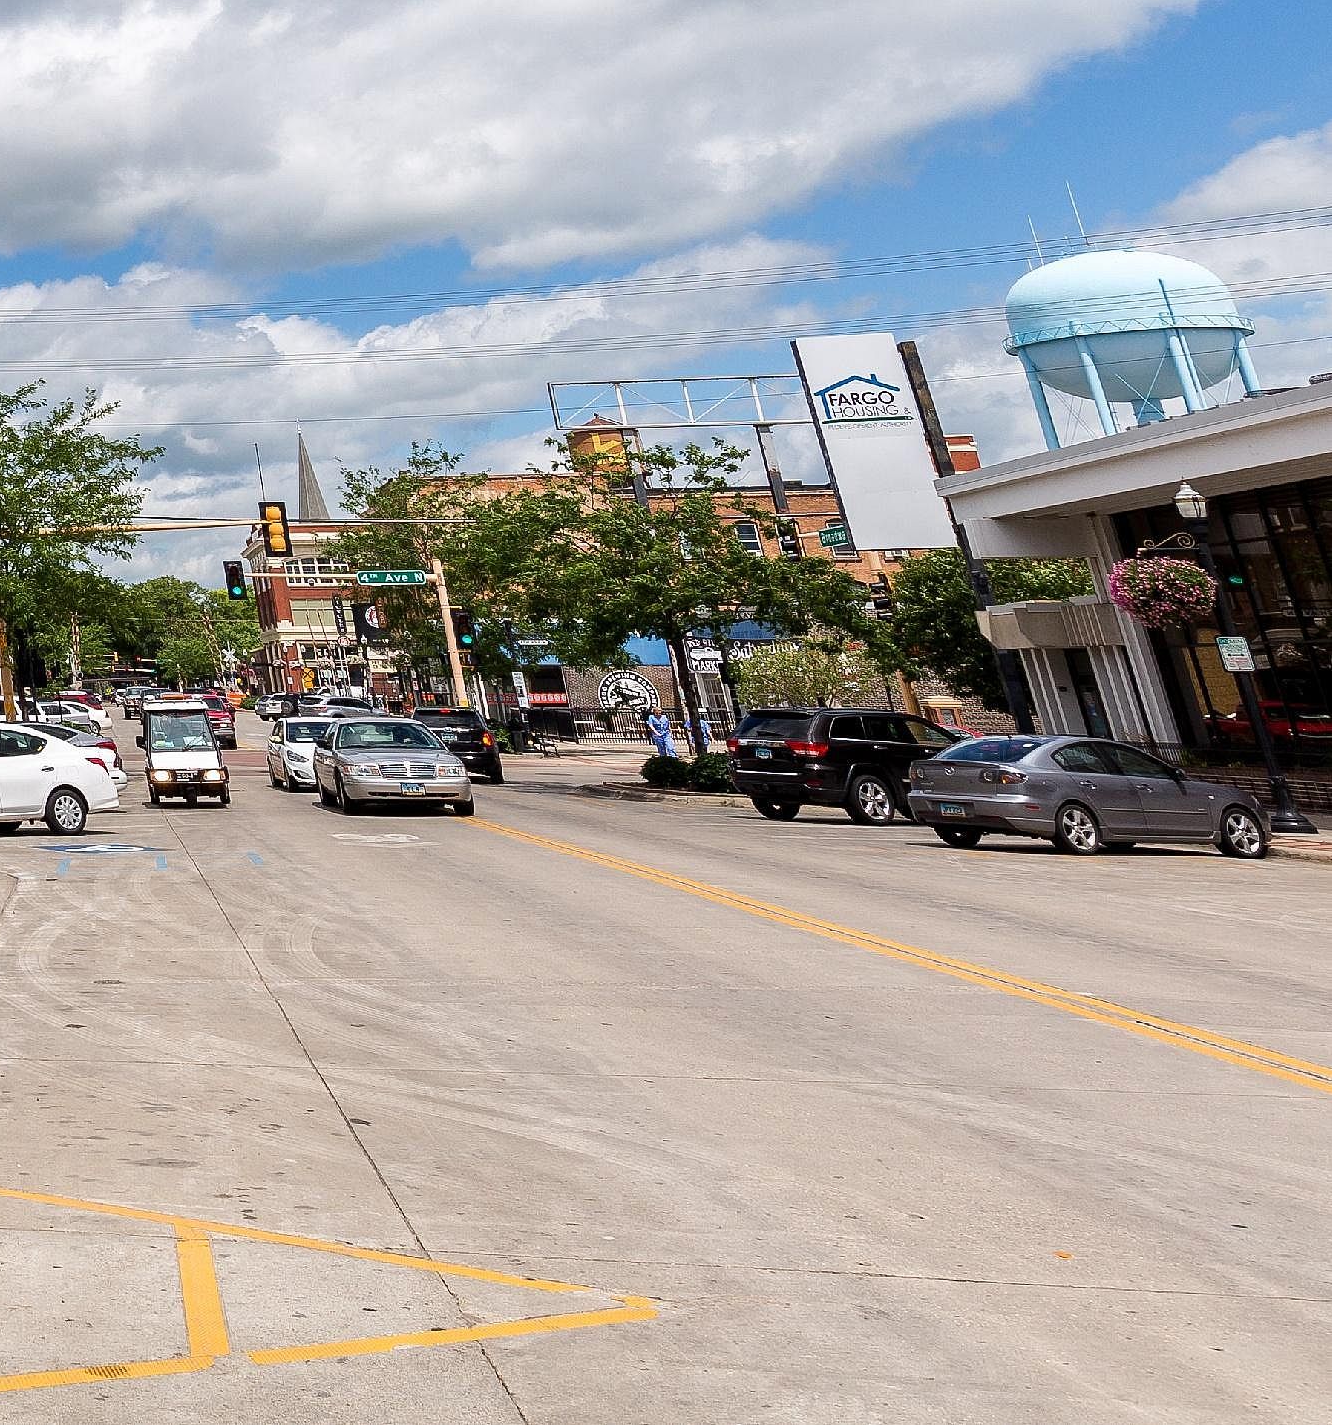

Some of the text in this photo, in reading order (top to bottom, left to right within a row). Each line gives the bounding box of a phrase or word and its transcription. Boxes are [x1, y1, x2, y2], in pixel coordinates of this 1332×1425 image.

[828, 390, 895, 407] FARGO
[832, 404, 899, 419] HOUSING
[360, 572, 423, 583] 4TH Ave N
